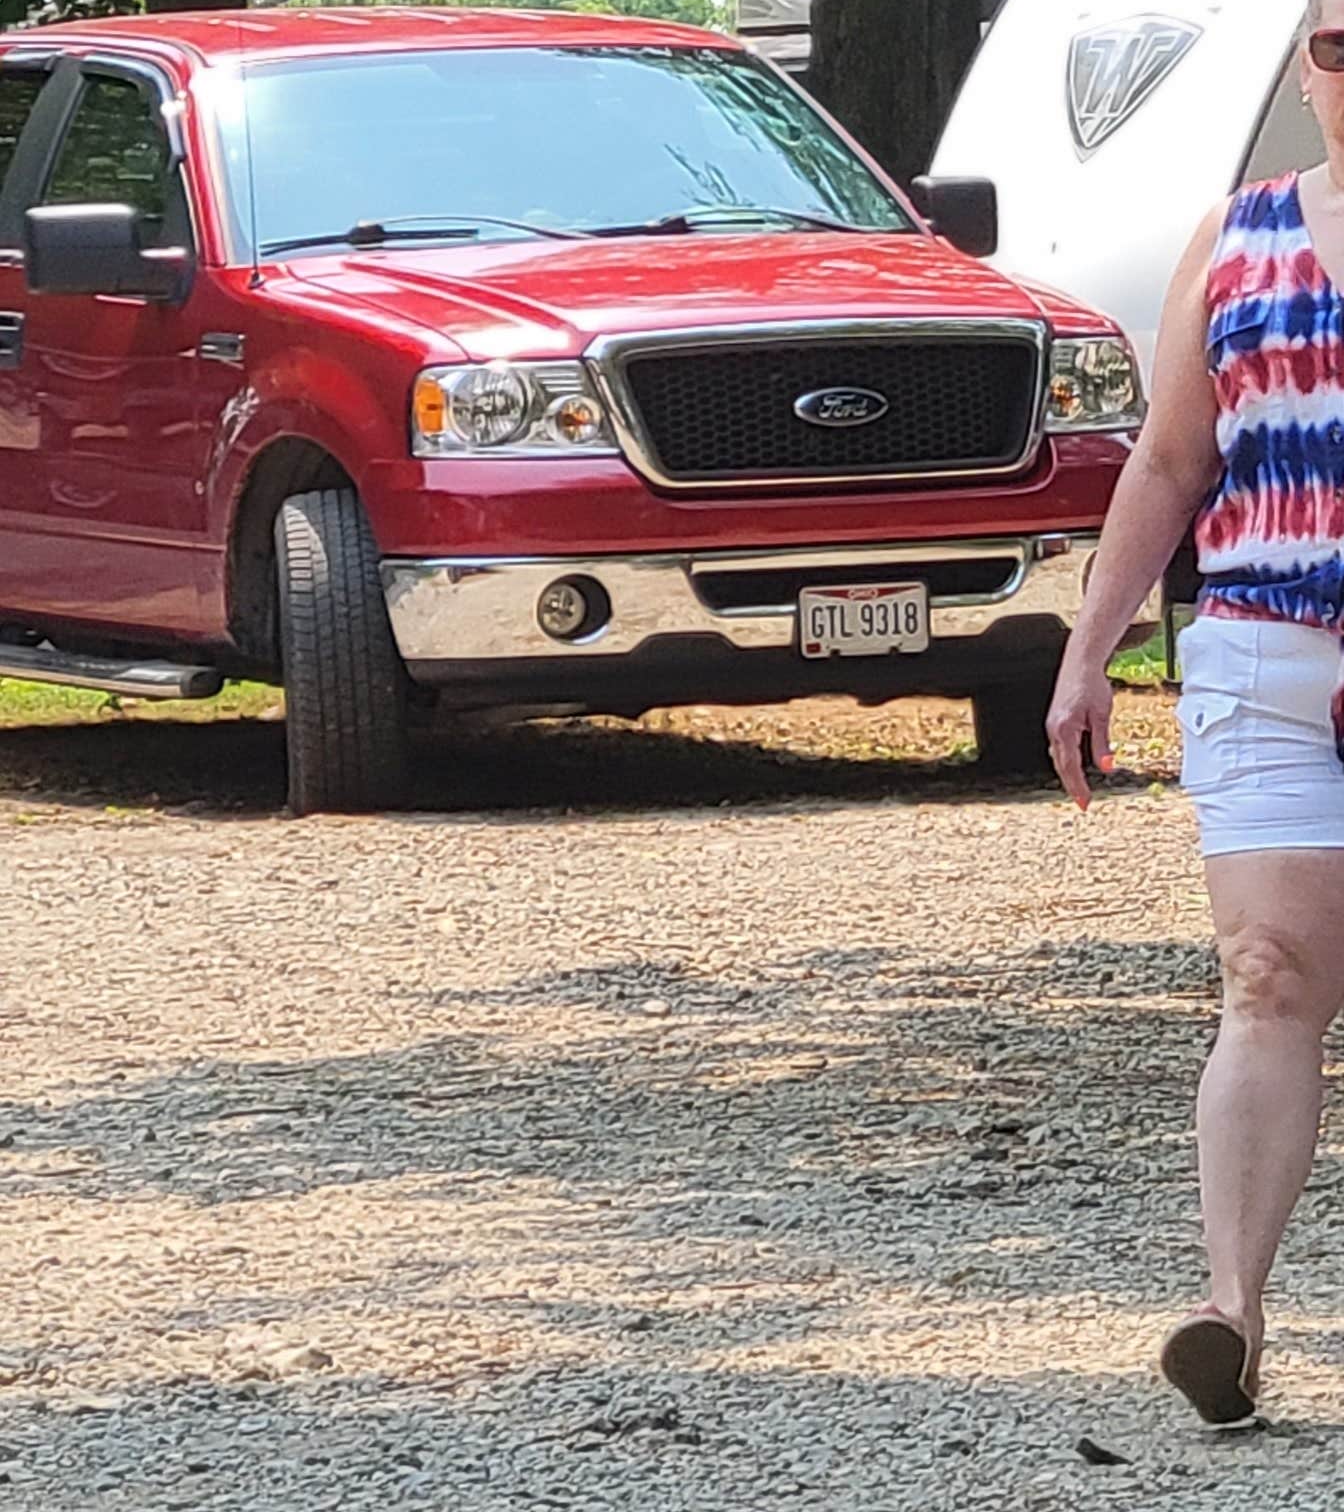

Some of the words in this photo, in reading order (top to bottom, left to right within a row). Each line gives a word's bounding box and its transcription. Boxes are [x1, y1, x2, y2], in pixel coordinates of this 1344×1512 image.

[818, 394, 869, 419] Ford
[811, 604, 854, 639] GTL
[860, 601, 919, 637] 9318
